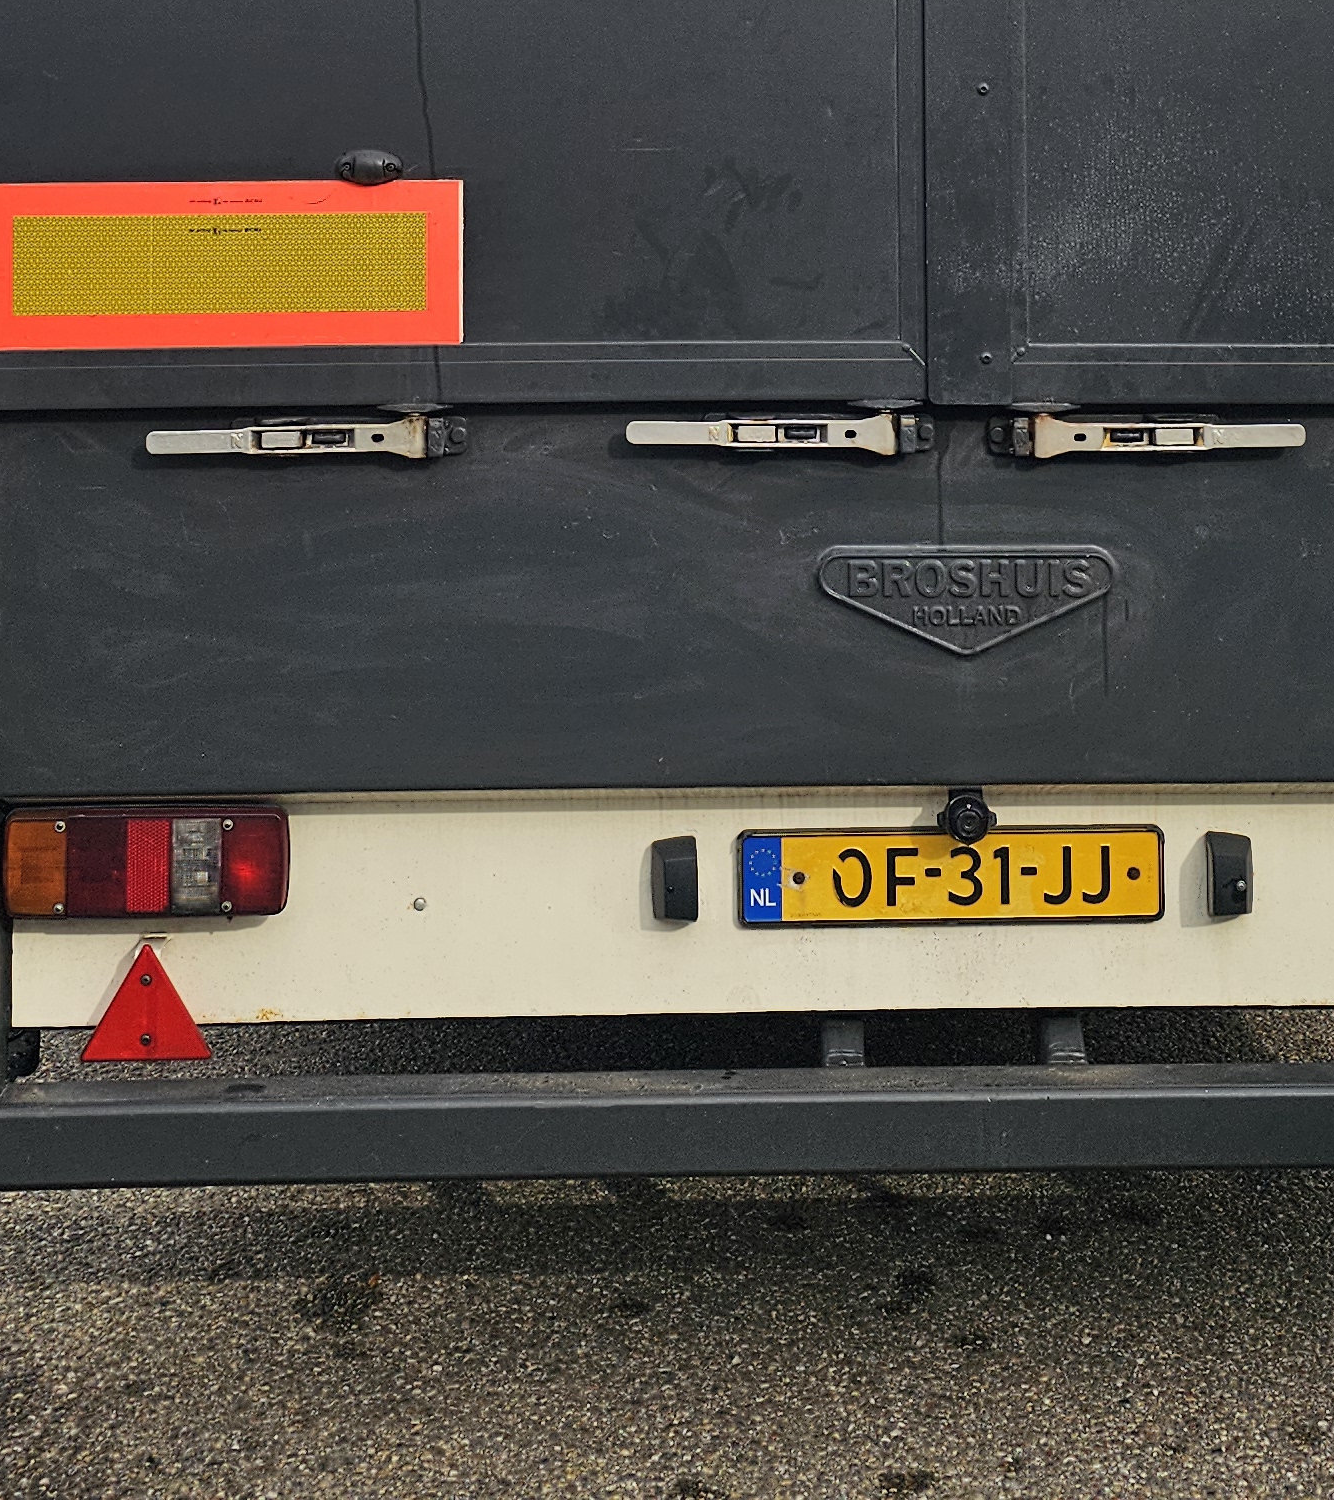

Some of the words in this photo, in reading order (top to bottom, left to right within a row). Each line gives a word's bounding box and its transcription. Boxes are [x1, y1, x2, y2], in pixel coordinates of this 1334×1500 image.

[847, 558, 1092, 598] BROSHUIS
[912, 605, 1022, 627] HOLLAND
[832, 844, 1111, 908] OF-31-JJ
[750, 887, 777, 908] NL
